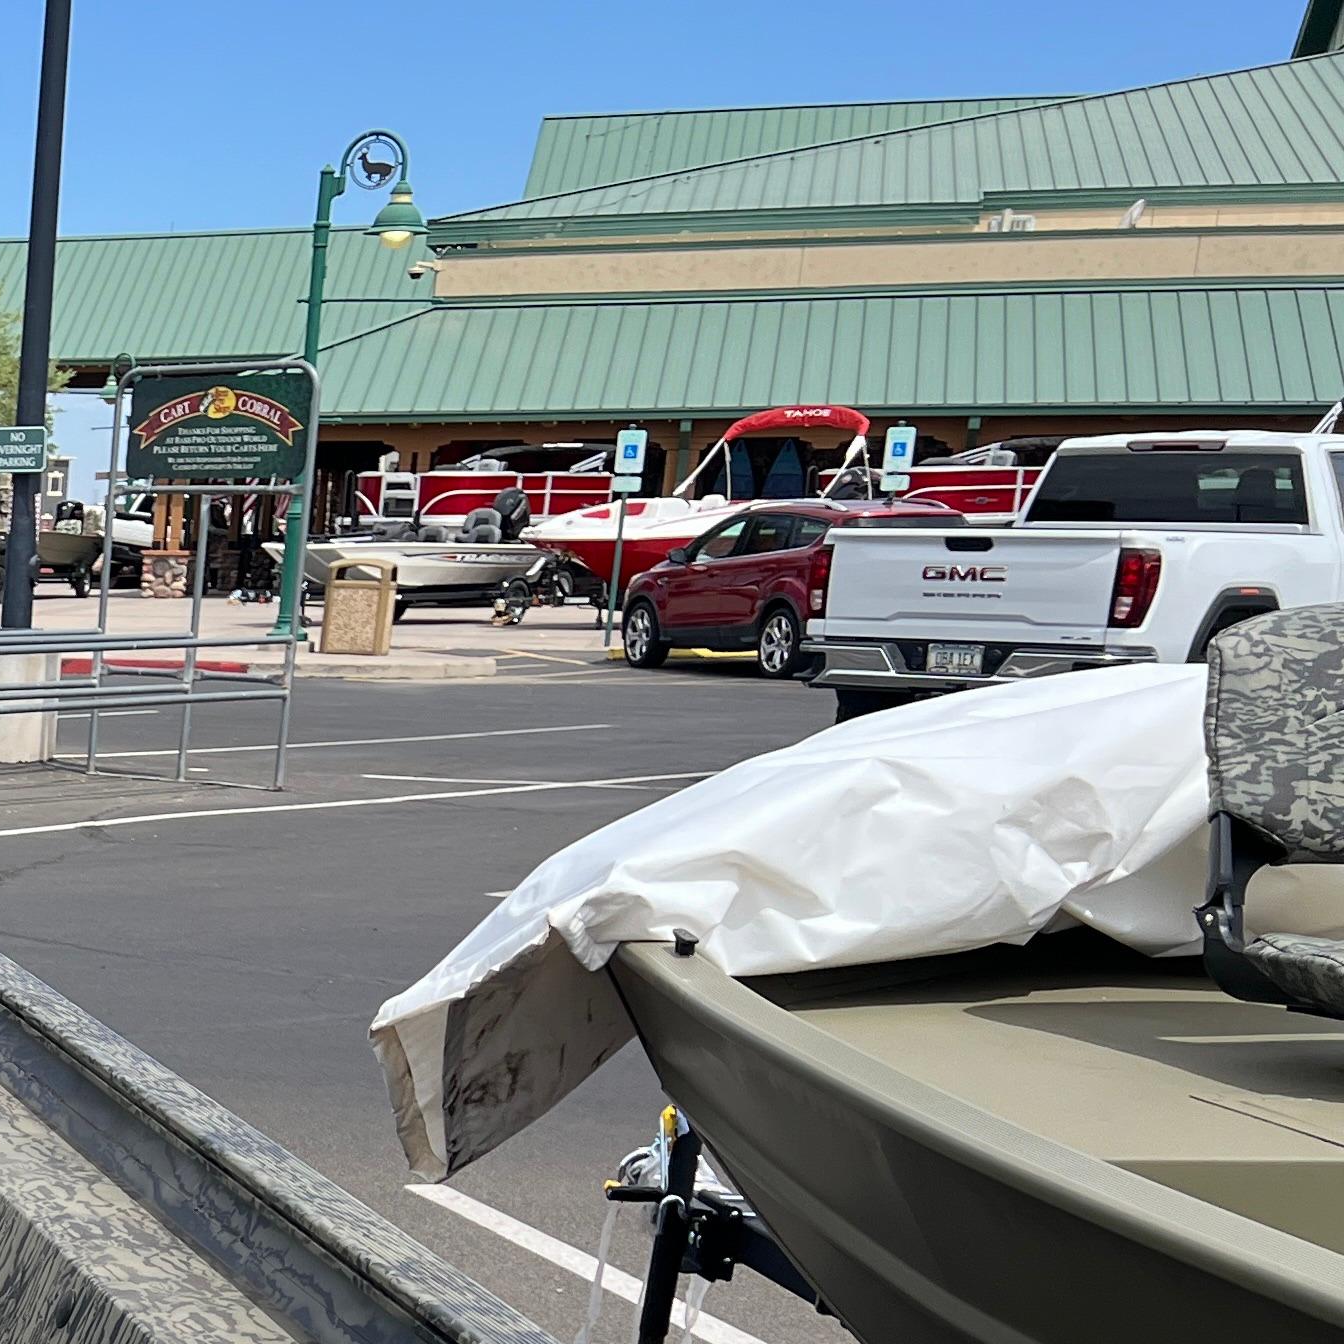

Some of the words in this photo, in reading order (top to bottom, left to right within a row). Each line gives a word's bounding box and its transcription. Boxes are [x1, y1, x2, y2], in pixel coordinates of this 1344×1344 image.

[160, 401, 191, 423] CART
[238, 396, 281, 424] CORRAL
[784, 409, 831, 418] TAHOE
[10, 432, 26, 442] NO
[922, 565, 1008, 582] GMC
